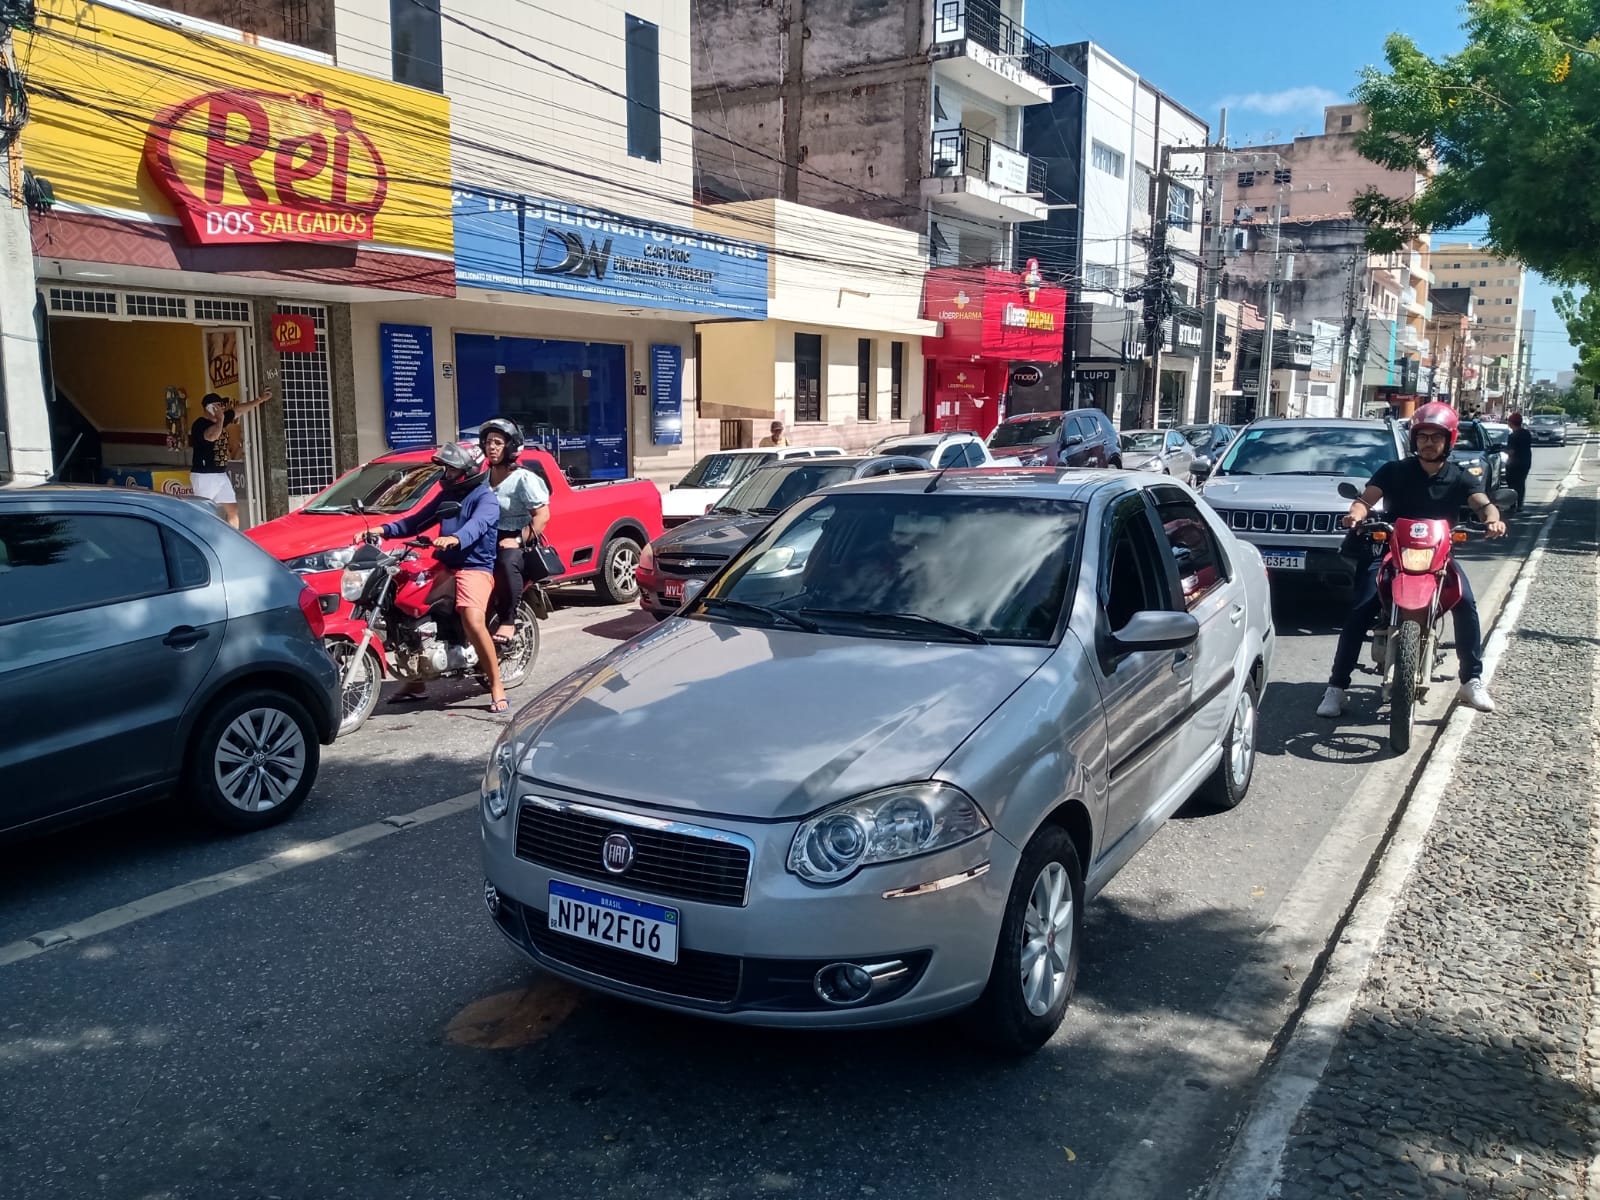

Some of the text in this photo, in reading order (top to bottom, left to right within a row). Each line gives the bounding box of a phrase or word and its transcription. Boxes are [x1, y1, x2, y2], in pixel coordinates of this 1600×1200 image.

[203, 101, 352, 205] Rei
[206, 211, 367, 235] DOS SALGADOS
[534, 224, 613, 279] DW
[280, 323, 298, 341] Rei
[213, 356, 235, 380] Rei
[1083, 371, 1110, 379] LUPO
[608, 843, 627, 865] FIAT
[601, 897, 622, 910] BRASIL
[558, 899, 661, 953] NPW2F06
